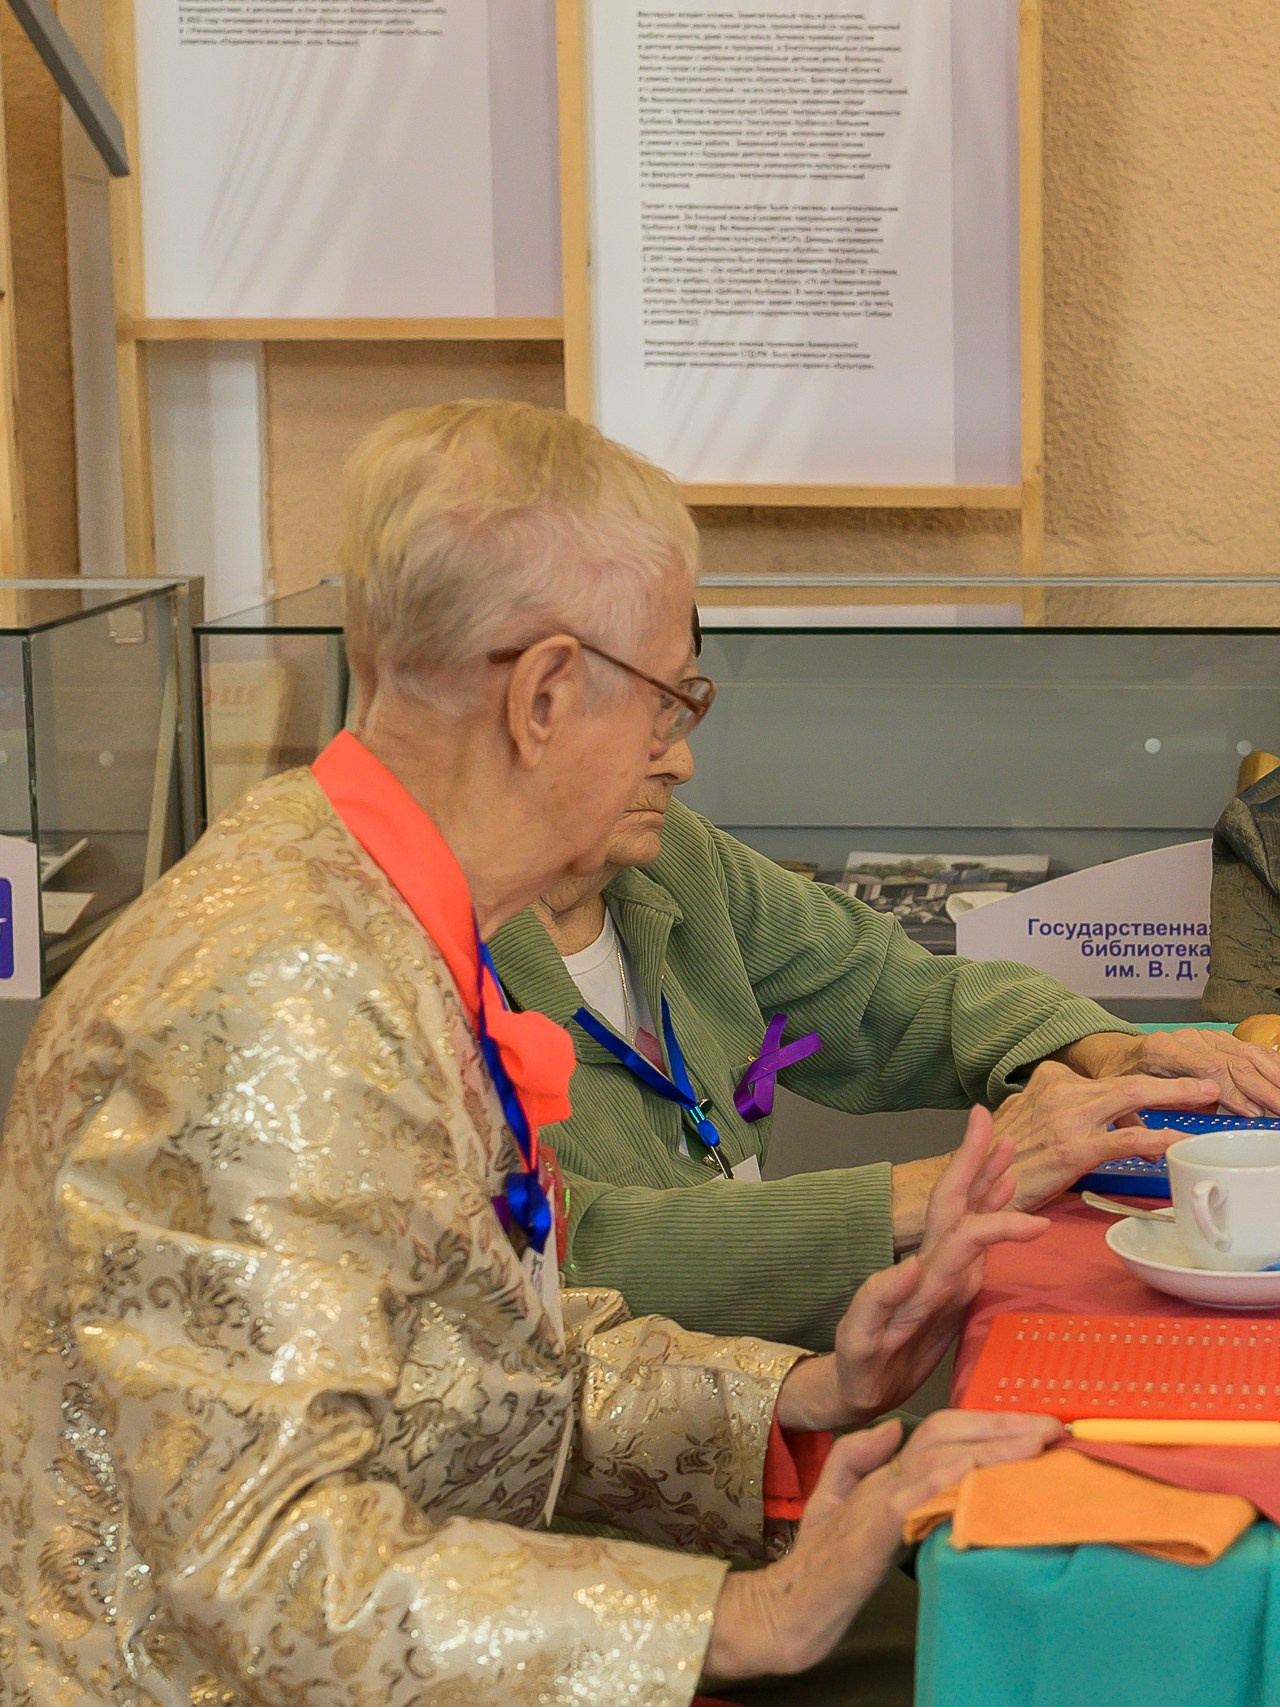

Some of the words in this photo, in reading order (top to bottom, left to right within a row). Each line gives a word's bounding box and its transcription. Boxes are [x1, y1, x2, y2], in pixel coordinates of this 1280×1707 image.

[1081, 939, 1210, 957] библиотека
[1105, 964, 1140, 978] им.
[1148, 961, 1169, 978] В.
[1176, 961, 1198, 981] Д.
